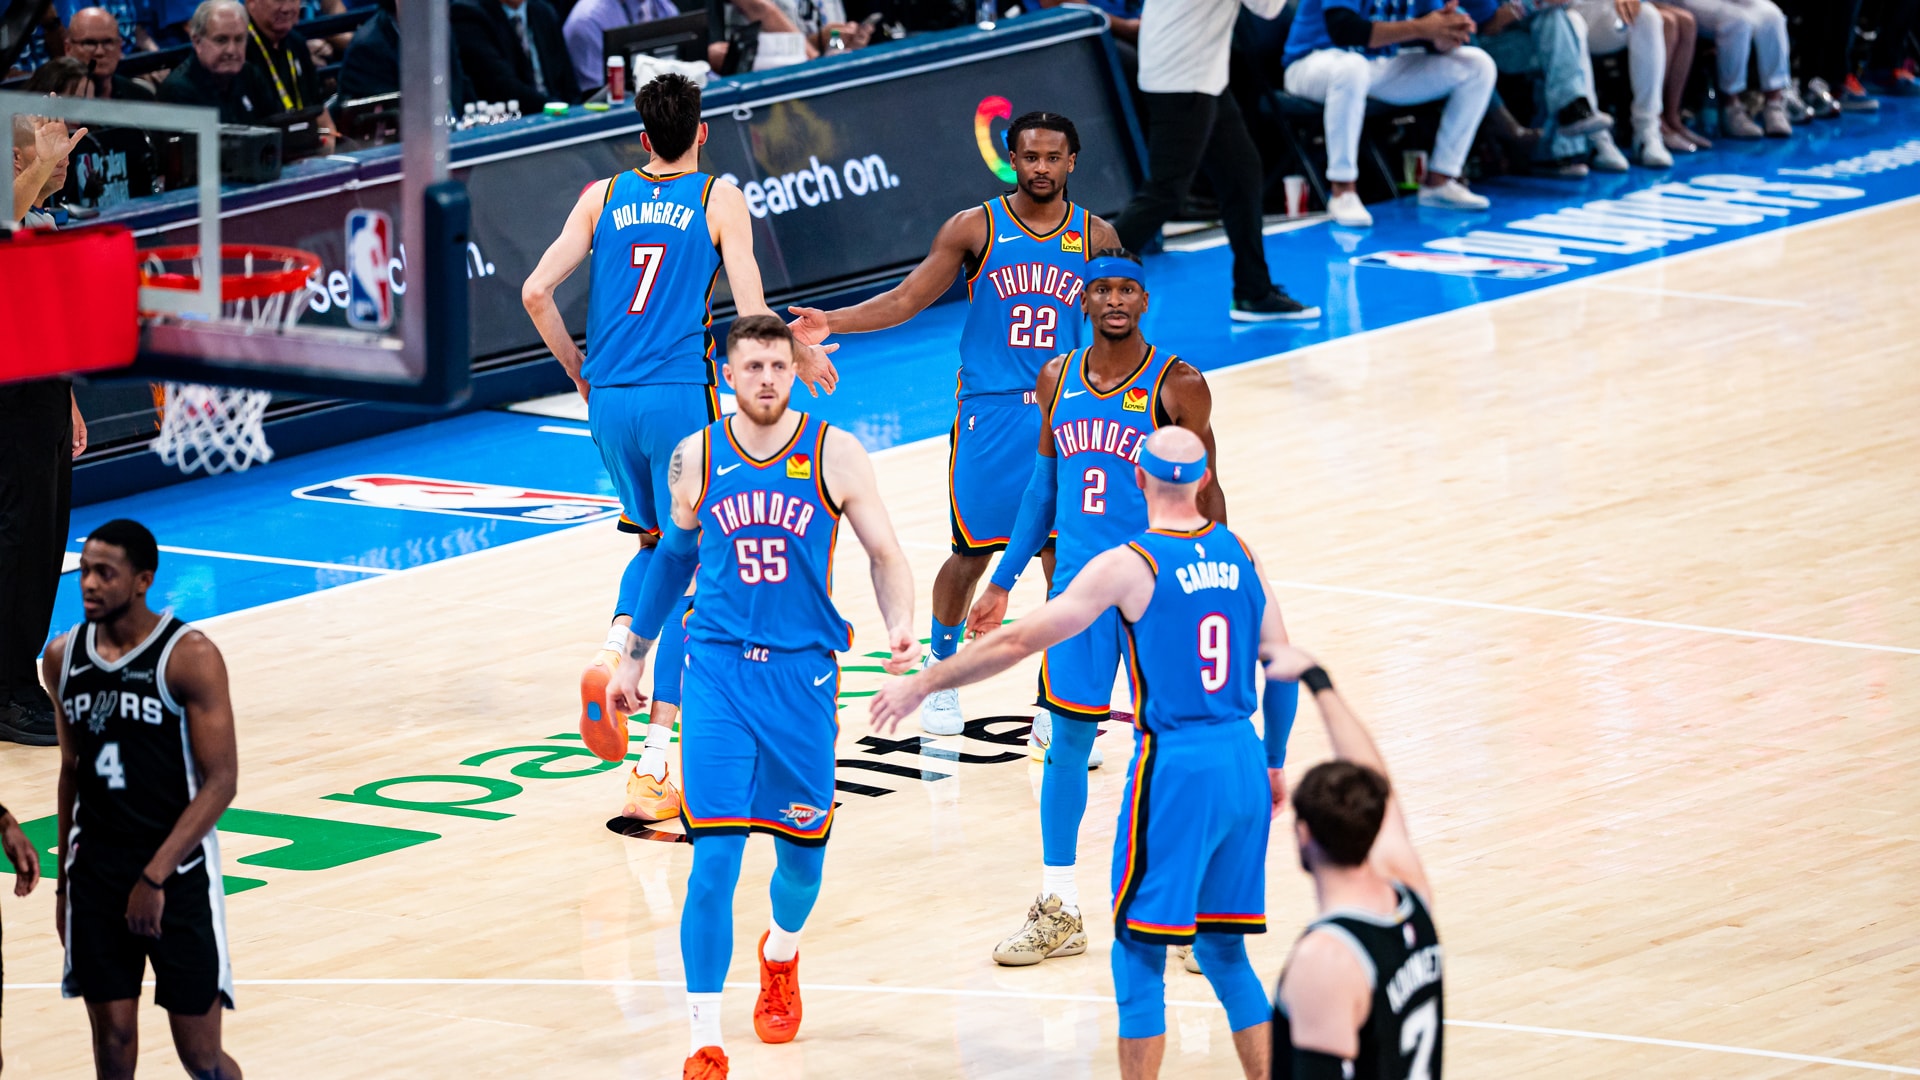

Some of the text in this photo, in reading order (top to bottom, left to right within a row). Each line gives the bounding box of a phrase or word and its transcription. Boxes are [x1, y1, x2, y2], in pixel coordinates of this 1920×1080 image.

[719, 154, 900, 219] earch on.
[612, 201, 695, 231] HOLMGREN
[626, 243, 667, 315] 7
[988, 262, 1085, 308] THUNDER
[1008, 304, 1058, 350] 22
[1022, 390, 1038, 405] OK
[1053, 418, 1147, 466] THUNDER
[710, 489, 815, 538] THUNDER
[1081, 466, 1108, 516] 2
[733, 537, 788, 586] 55
[1175, 561, 1240, 595] CARUSO
[1197, 611, 1231, 695] 9
[62, 689, 163, 734] SPURS
[94, 741, 127, 790] 4
